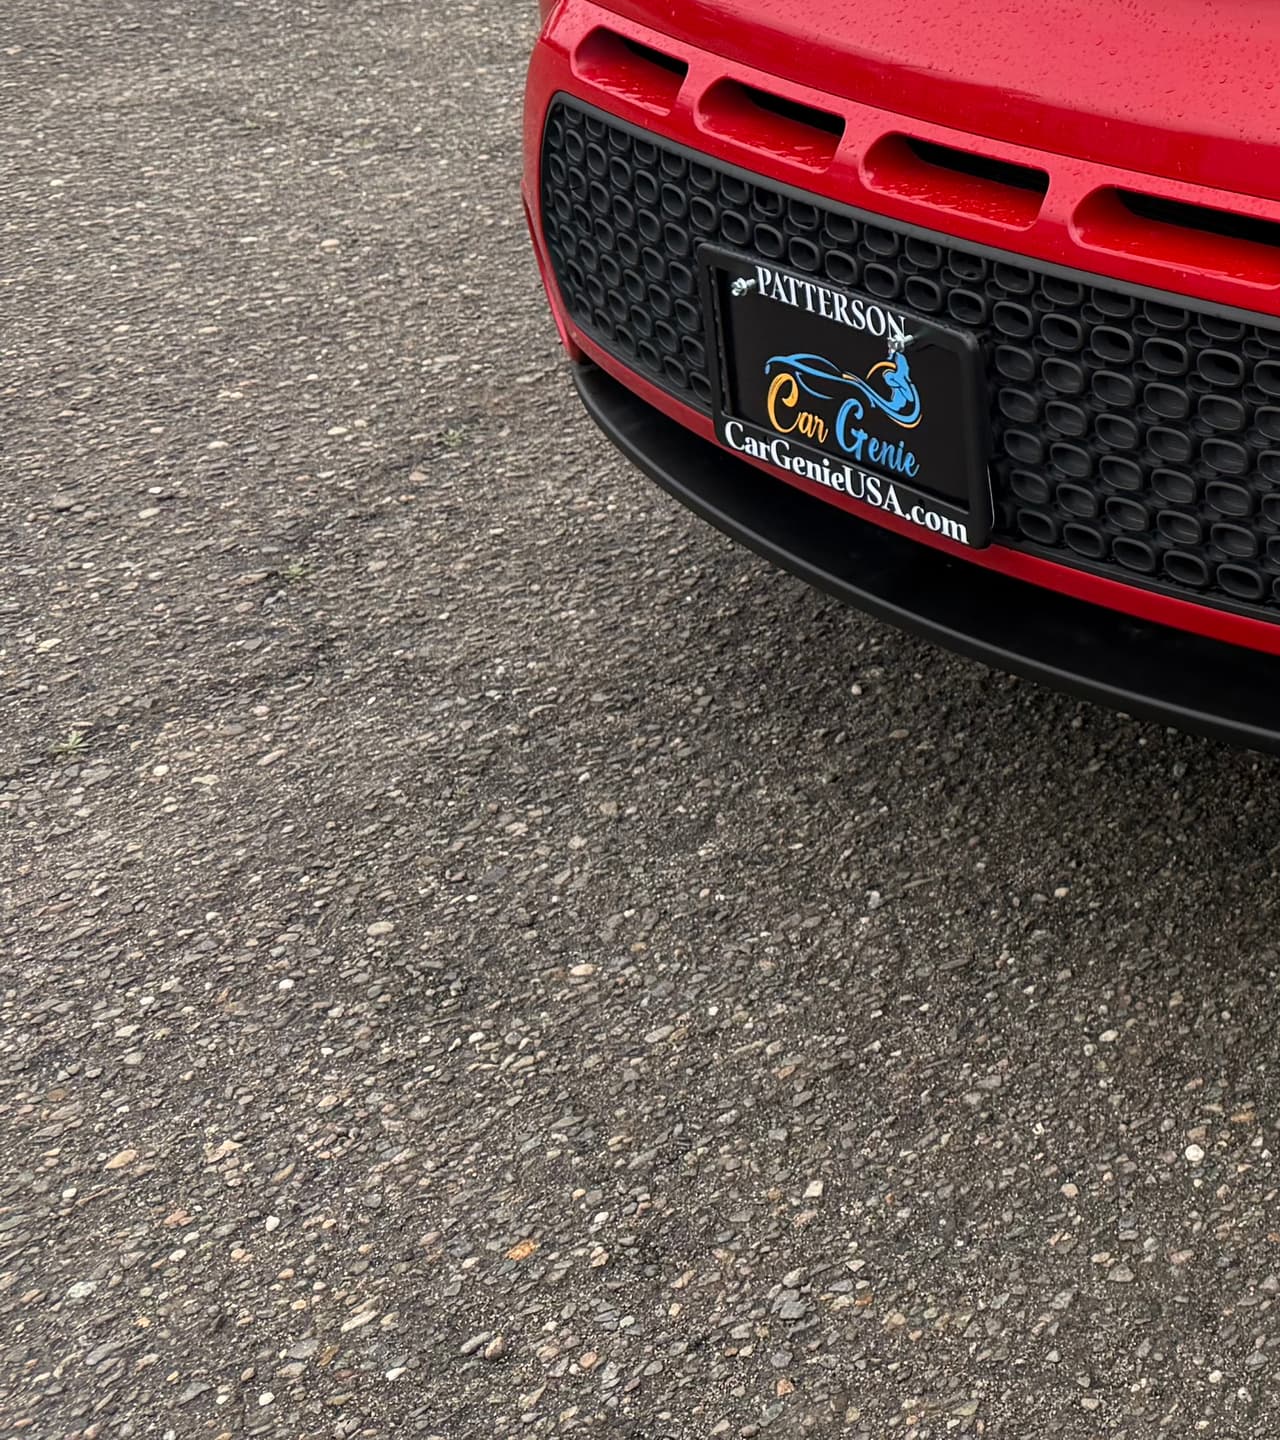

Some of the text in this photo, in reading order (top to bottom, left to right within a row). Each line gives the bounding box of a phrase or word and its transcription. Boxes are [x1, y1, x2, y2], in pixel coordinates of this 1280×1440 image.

[755, 265, 907, 340] PATTERSON
[767, 373, 919, 478] Car Genie
[725, 421, 969, 545] CarGenieUSA.com
